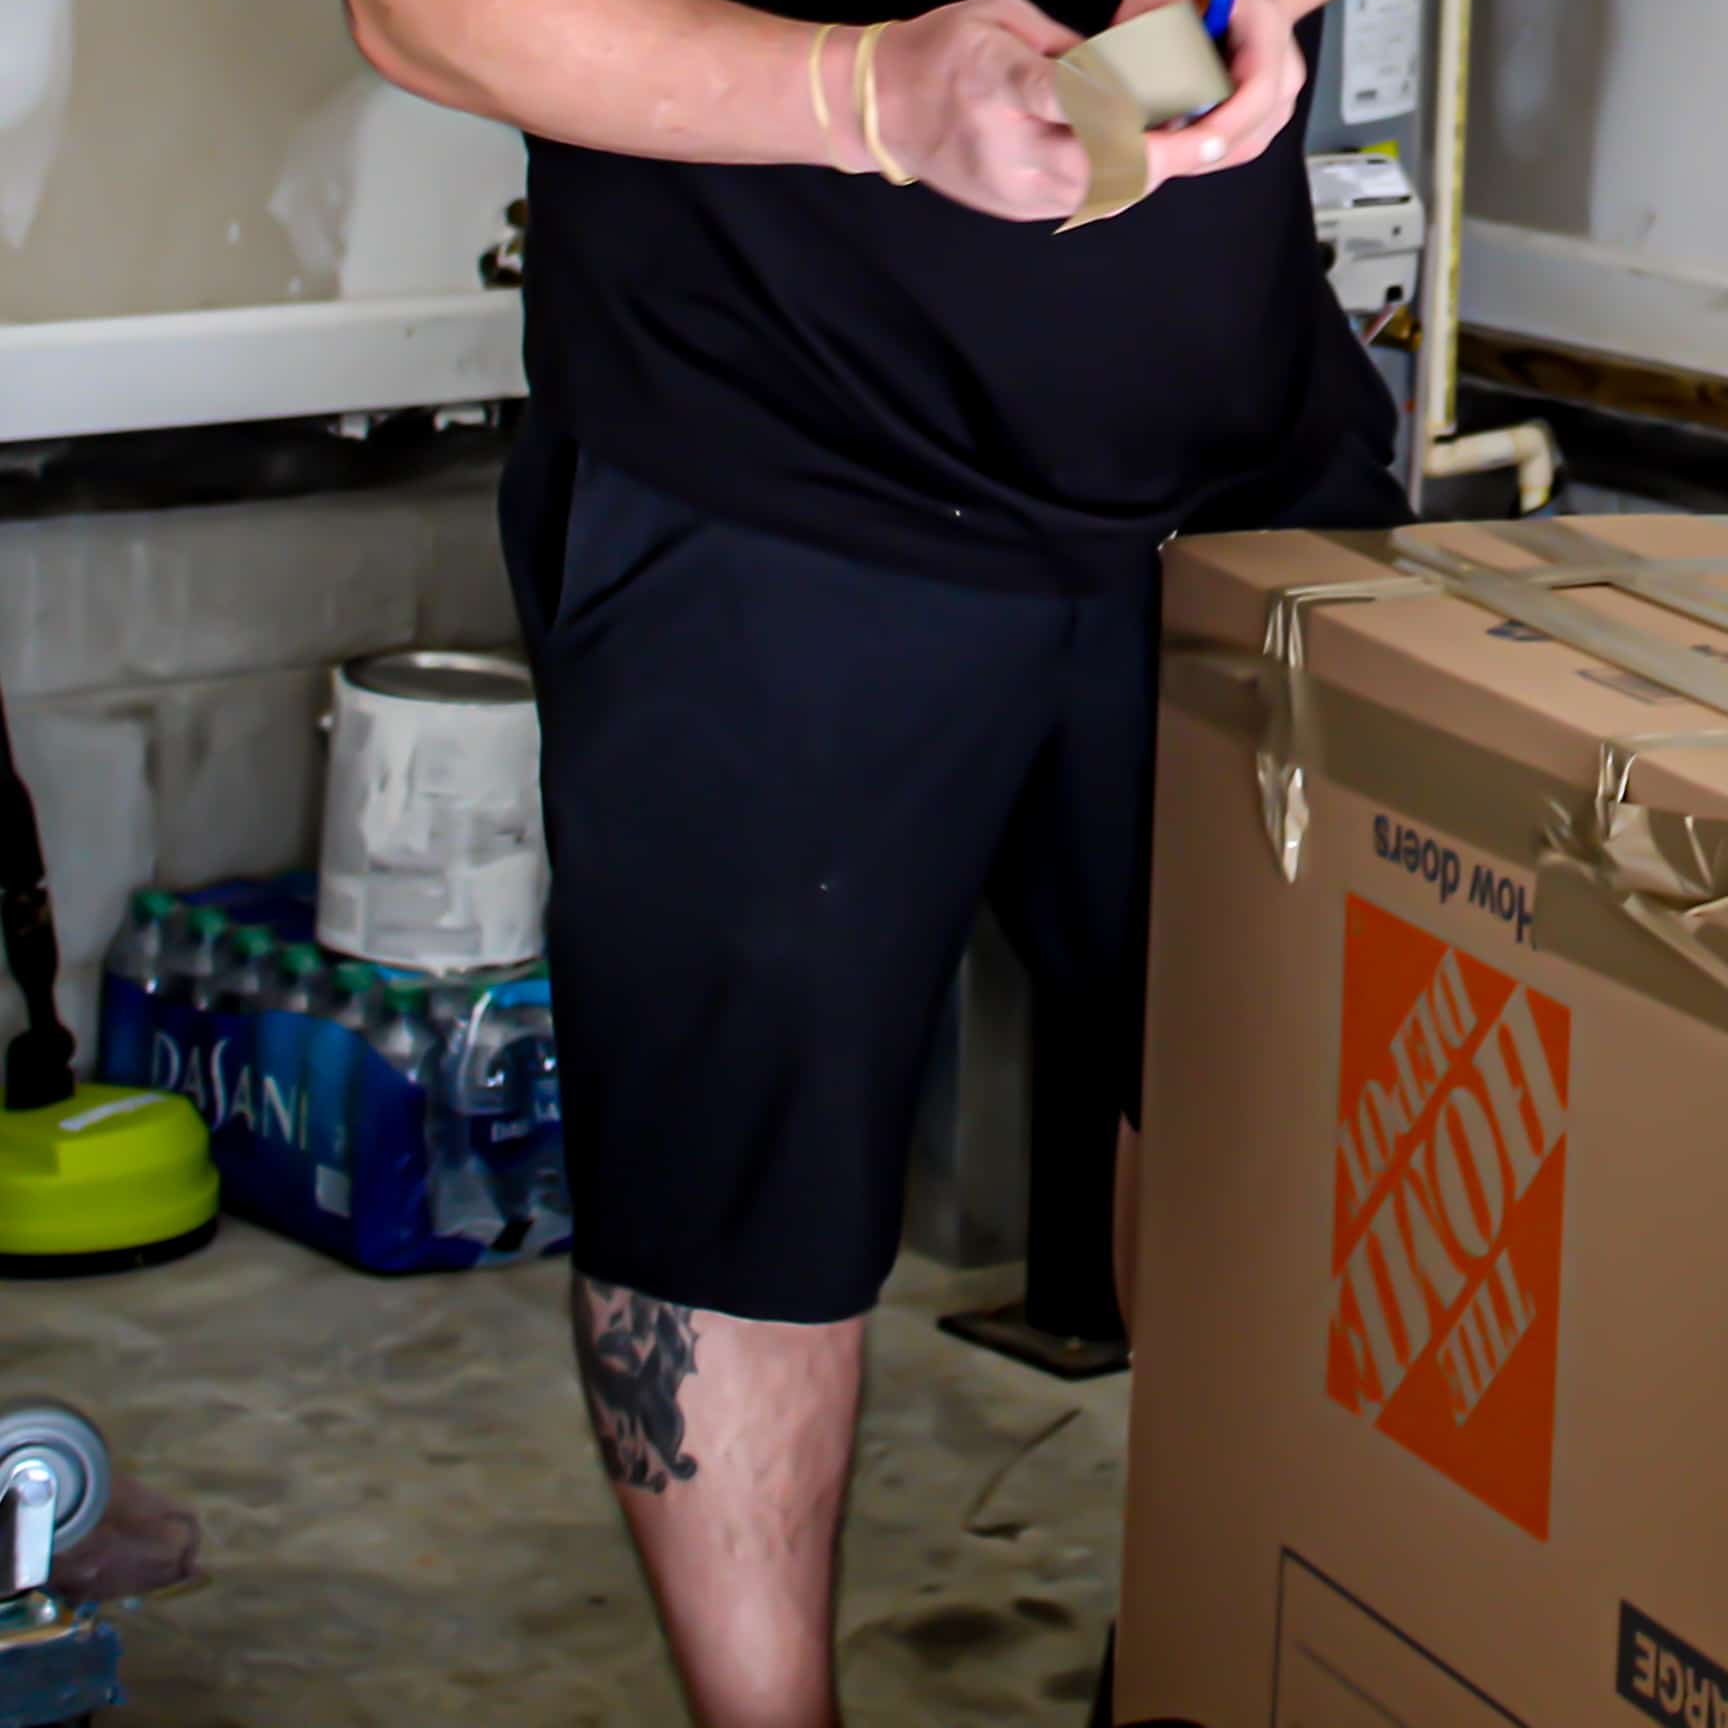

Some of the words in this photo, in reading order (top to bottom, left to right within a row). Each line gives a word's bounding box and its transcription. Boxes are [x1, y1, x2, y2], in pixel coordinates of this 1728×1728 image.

[1373, 814, 1461, 905] doers
[152, 1030, 311, 1151] DASANI
[1337, 944, 1479, 1220] DEPOT
[1329, 980, 1569, 1425] HOME
[1436, 1246, 1537, 1428] THE
